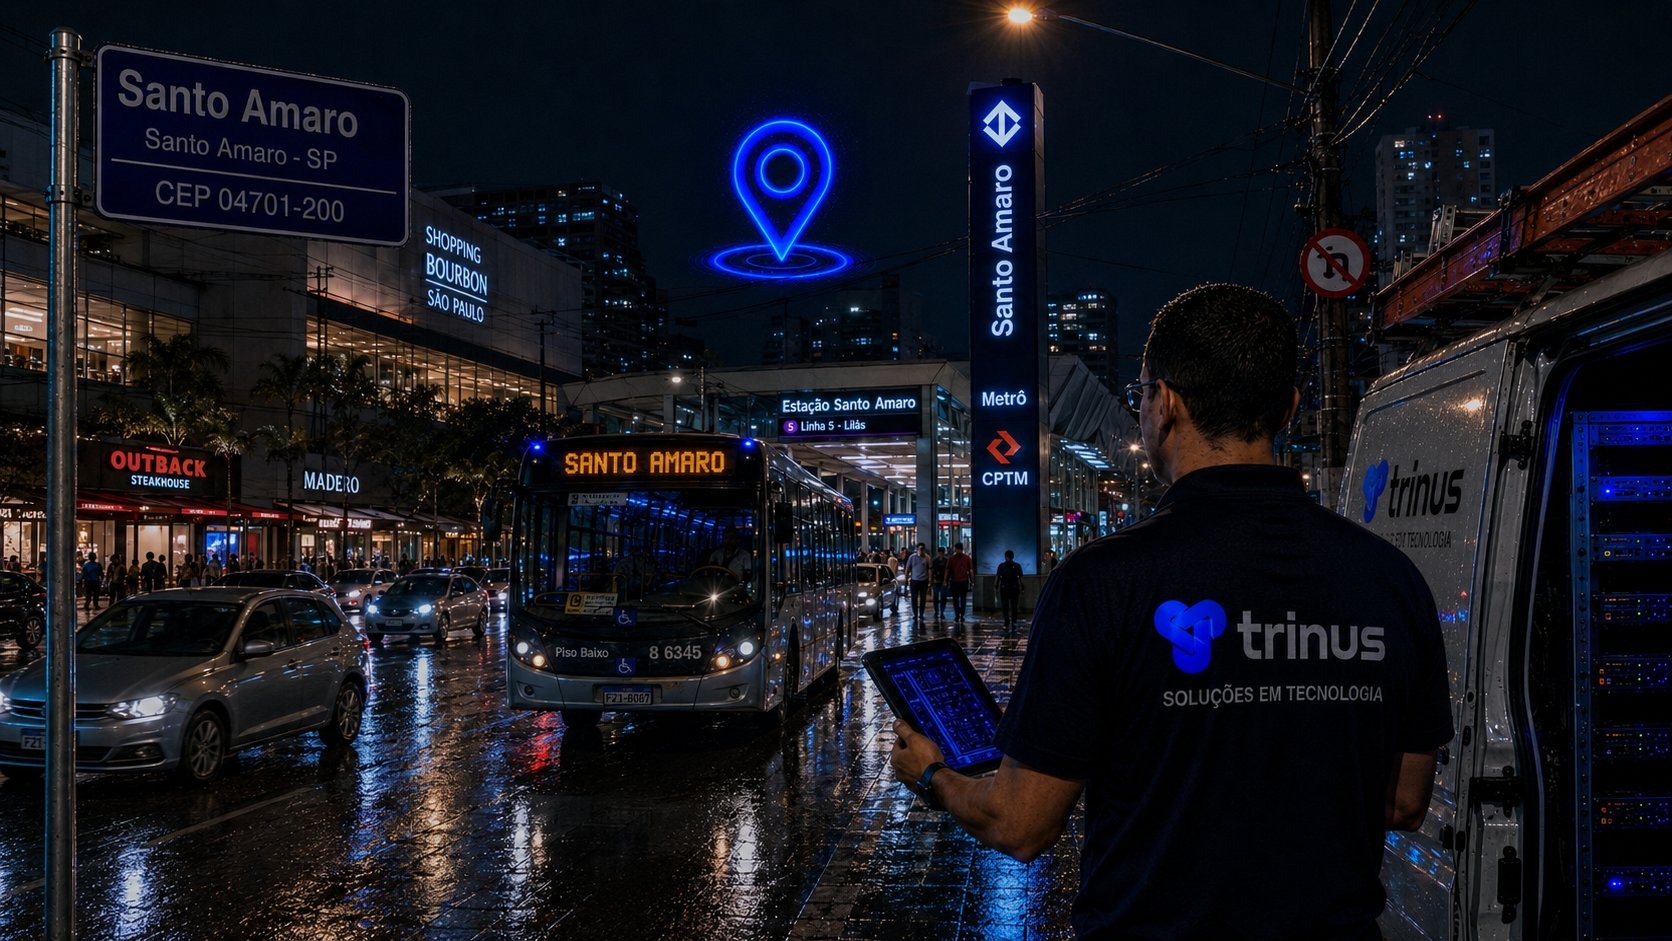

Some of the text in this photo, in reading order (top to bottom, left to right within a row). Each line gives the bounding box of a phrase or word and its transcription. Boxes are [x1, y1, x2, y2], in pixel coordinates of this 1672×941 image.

[118, 69, 358, 138] Santo Amaro
[145, 128, 209, 156] Santo
[217, 137, 287, 166] Amaro
[307, 148, 338, 170] SP
[155, 180, 345, 223] CEP 04701-200
[425, 225, 481, 264] SHOPPING
[991, 164, 1013, 337] Santo Amaro
[426, 252, 488, 296] BOURBON
[427, 288, 484, 323] SÃO PAULO
[782, 396, 916, 415] Estação Santo Amaro
[982, 389, 1027, 407] Metrô
[787, 422, 794, 431] 5
[801, 421, 825, 431] Linha
[828, 421, 835, 430] 5
[844, 420, 866, 430] Lilás
[110, 450, 207, 478] OUTBACK
[565, 451, 726, 474] SANTO AMARO
[130, 475, 190, 489] STEAKHOUSE
[303, 470, 360, 494] MADERO
[982, 471, 1028, 486] CPTM
[1388, 459, 1465, 518] trinus
[1407, 530, 1452, 549] TECNOLOGIA
[1237, 610, 1386, 661] trinus
[555, 647, 609, 658] Piso Baixo
[649, 645, 702, 660] 8 6345
[1162, 683, 1383, 709] SOLUÇÕES EM TECNOLOGIA
